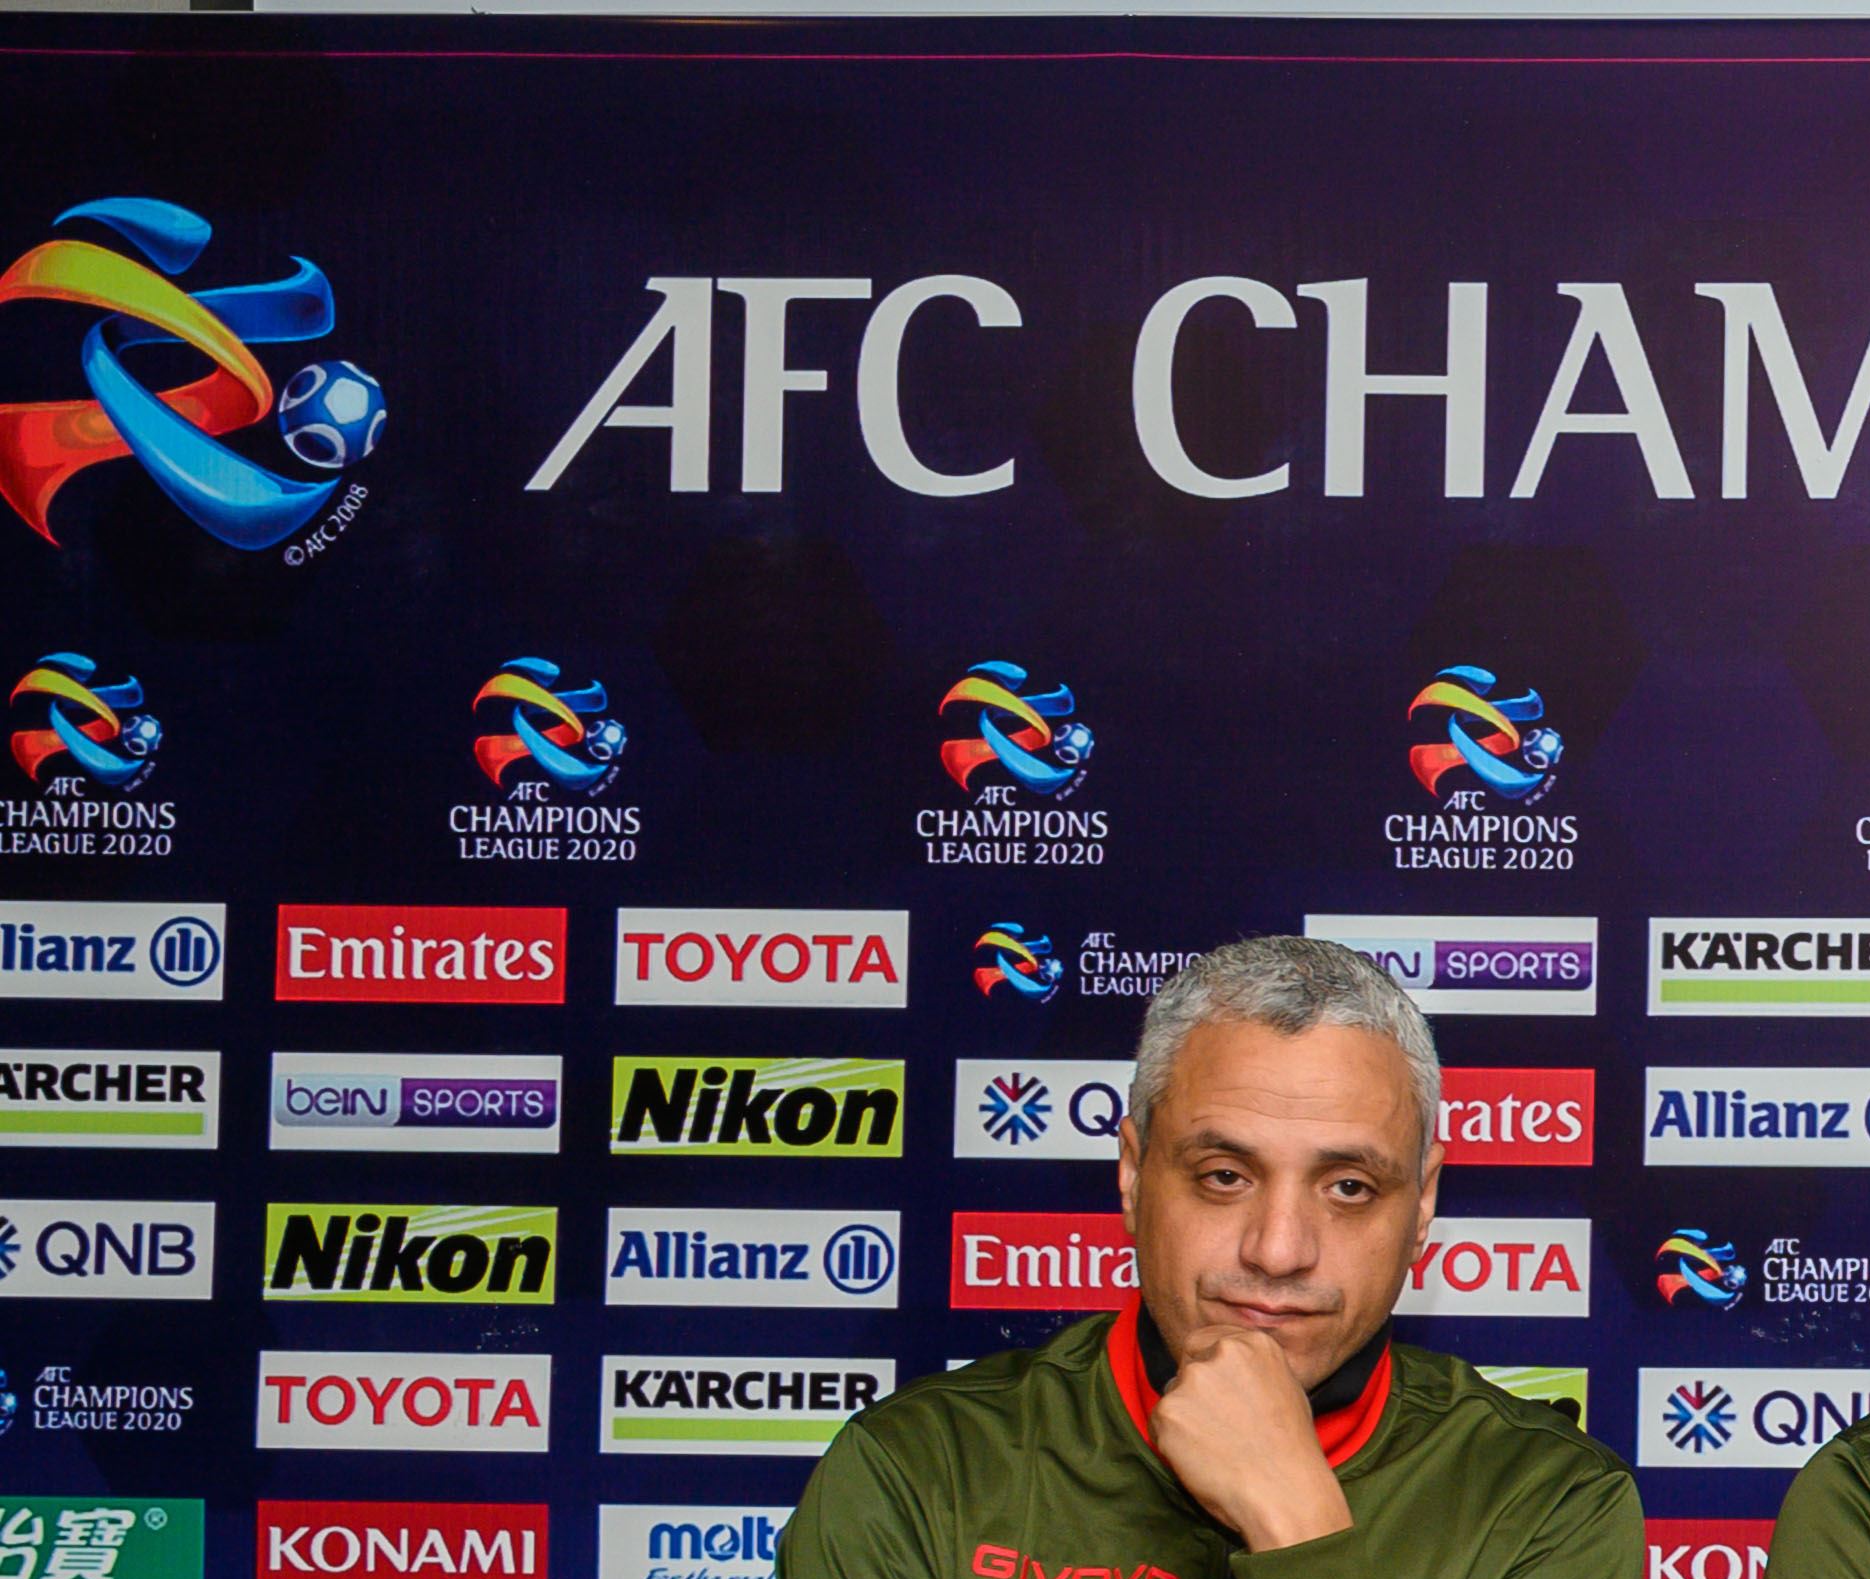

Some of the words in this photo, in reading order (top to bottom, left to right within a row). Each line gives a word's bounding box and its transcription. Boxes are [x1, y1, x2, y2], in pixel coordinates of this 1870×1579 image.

[524, 275, 1022, 497] AFC
[46, 777, 85, 796] AFC
[509, 782, 549, 801] AFC
[975, 786, 1016, 806] AFC
[1444, 791, 1485, 810] AFC
[450, 806, 640, 834] CHAMPIONS
[917, 810, 1107, 838] CHAMPIONS
[1385, 815, 1577, 843] CHAMPIONS
[102, 834, 171, 855] 2020
[460, 838, 559, 859] LEAGUE
[567, 839, 636, 860] 2020
[927, 842, 1026, 863] LEAGUE
[1034, 843, 1103, 864] 2020
[1395, 847, 1496, 869] LEAGUE
[1504, 848, 1573, 869] 2020
[288, 926, 553, 980] Emirates
[1081, 932, 1115, 948] AFC
[624, 932, 898, 983] TOYOTA
[1448, 951, 1580, 979] SPORTS
[414, 1089, 543, 1117] SPORTS
[617, 1068, 898, 1146] Nikon
[1650, 1090, 1849, 1138] Allianz
[1438, 1092, 1583, 1144] rates
[36, 1221, 195, 1277] QNB
[271, 1213, 551, 1294] Nikon
[611, 1231, 808, 1279] Allianz
[964, 1233, 1140, 1288] Emira
[1765, 1239, 1799, 1255] AFC
[1765, 1283, 1848, 1302] LEAGUE
[36, 1367, 71, 1382] AFC
[34, 1386, 193, 1409] CHAMPIONS
[265, 1376, 540, 1427] TOYOTA
[615, 1371, 878, 1411] KÄRCHER
[34, 1411, 117, 1430] LEAGUE
[123, 1412, 181, 1430] 2020
[270, 1526, 535, 1574] KONAMI
